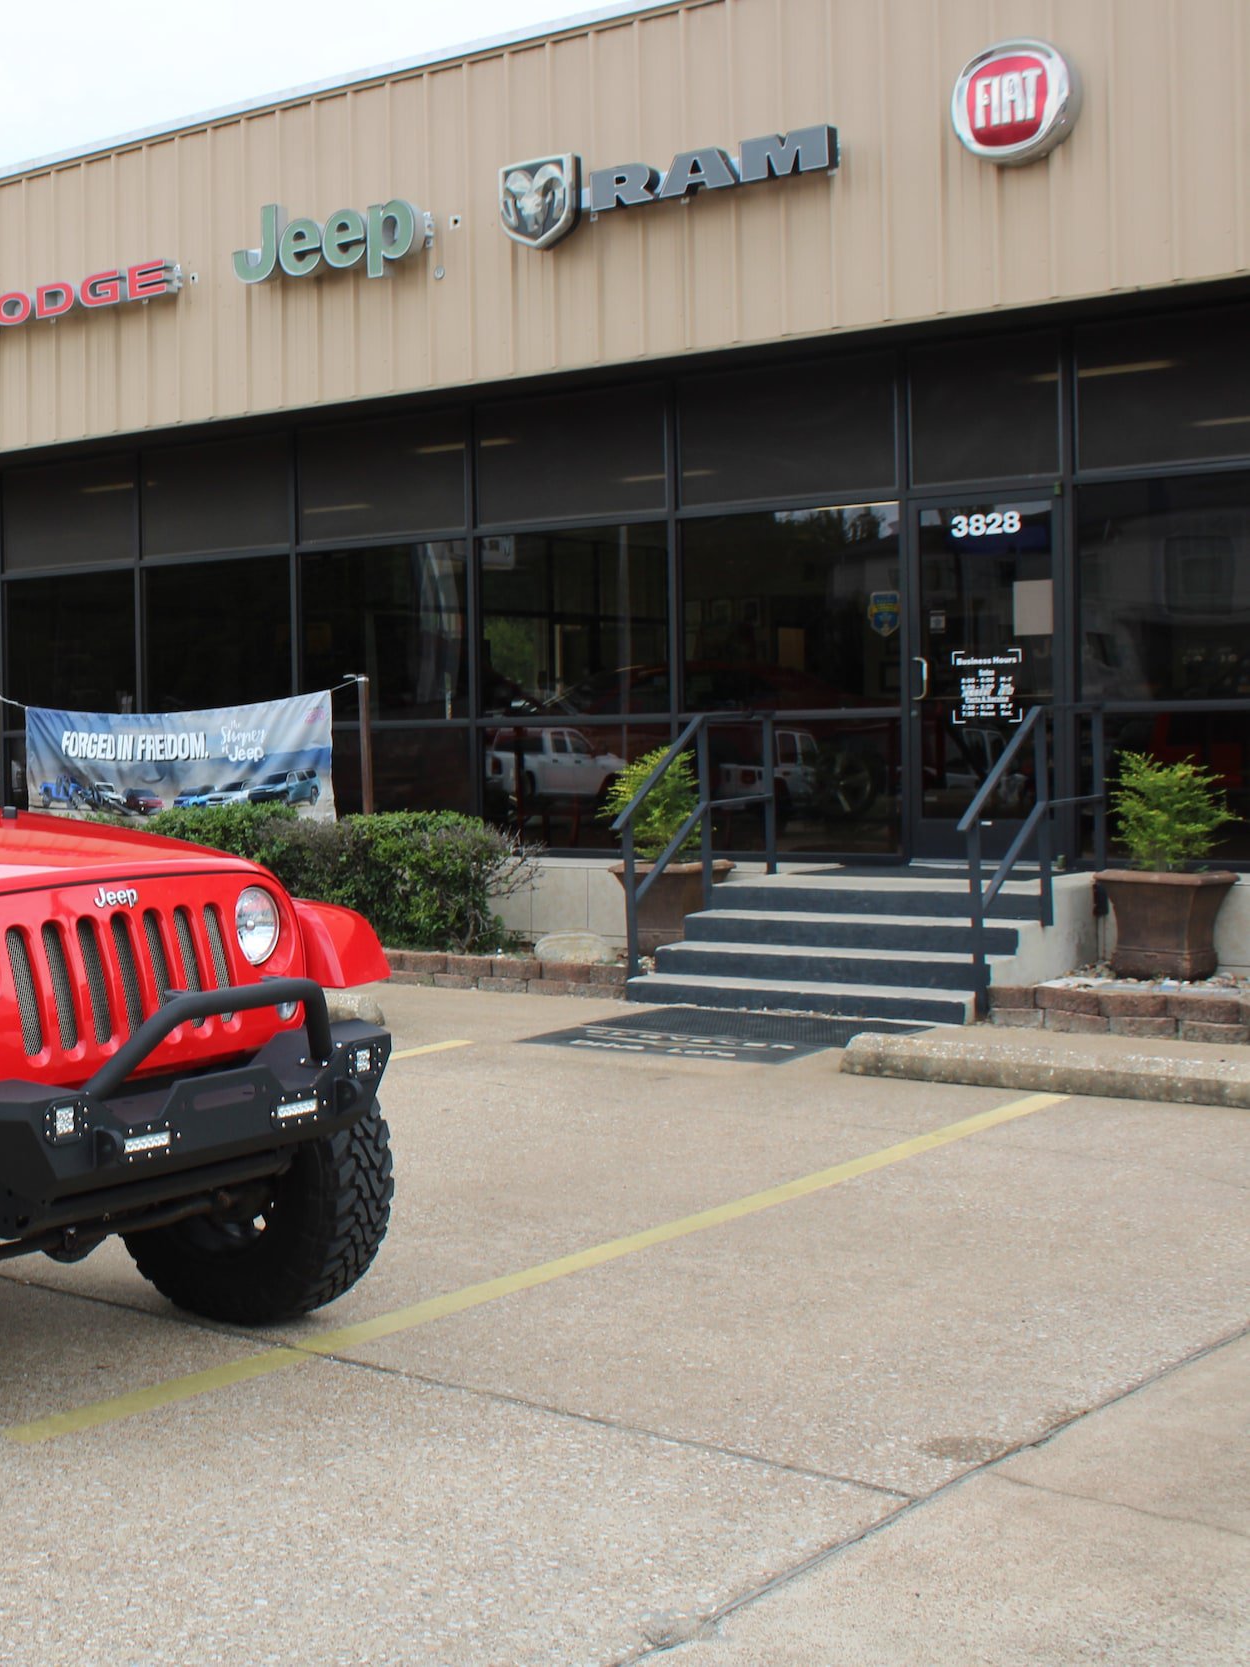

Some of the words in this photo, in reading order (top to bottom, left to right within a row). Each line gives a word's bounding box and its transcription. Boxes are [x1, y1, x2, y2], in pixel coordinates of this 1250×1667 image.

[974, 67, 1044, 129] FIAT
[589, 124, 836, 213] RAM
[232, 198, 418, 285] Jeep
[951, 511, 1021, 538] 3828
[956, 656, 991, 666] Business
[993, 656, 1017, 665] Hours
[61, 731, 116, 760] FORGED
[117, 733, 134, 761] IN
[137, 731, 210, 761] FREDOM.
[228, 745, 265, 762] Jeep
[94, 887, 138, 908] Jeep
